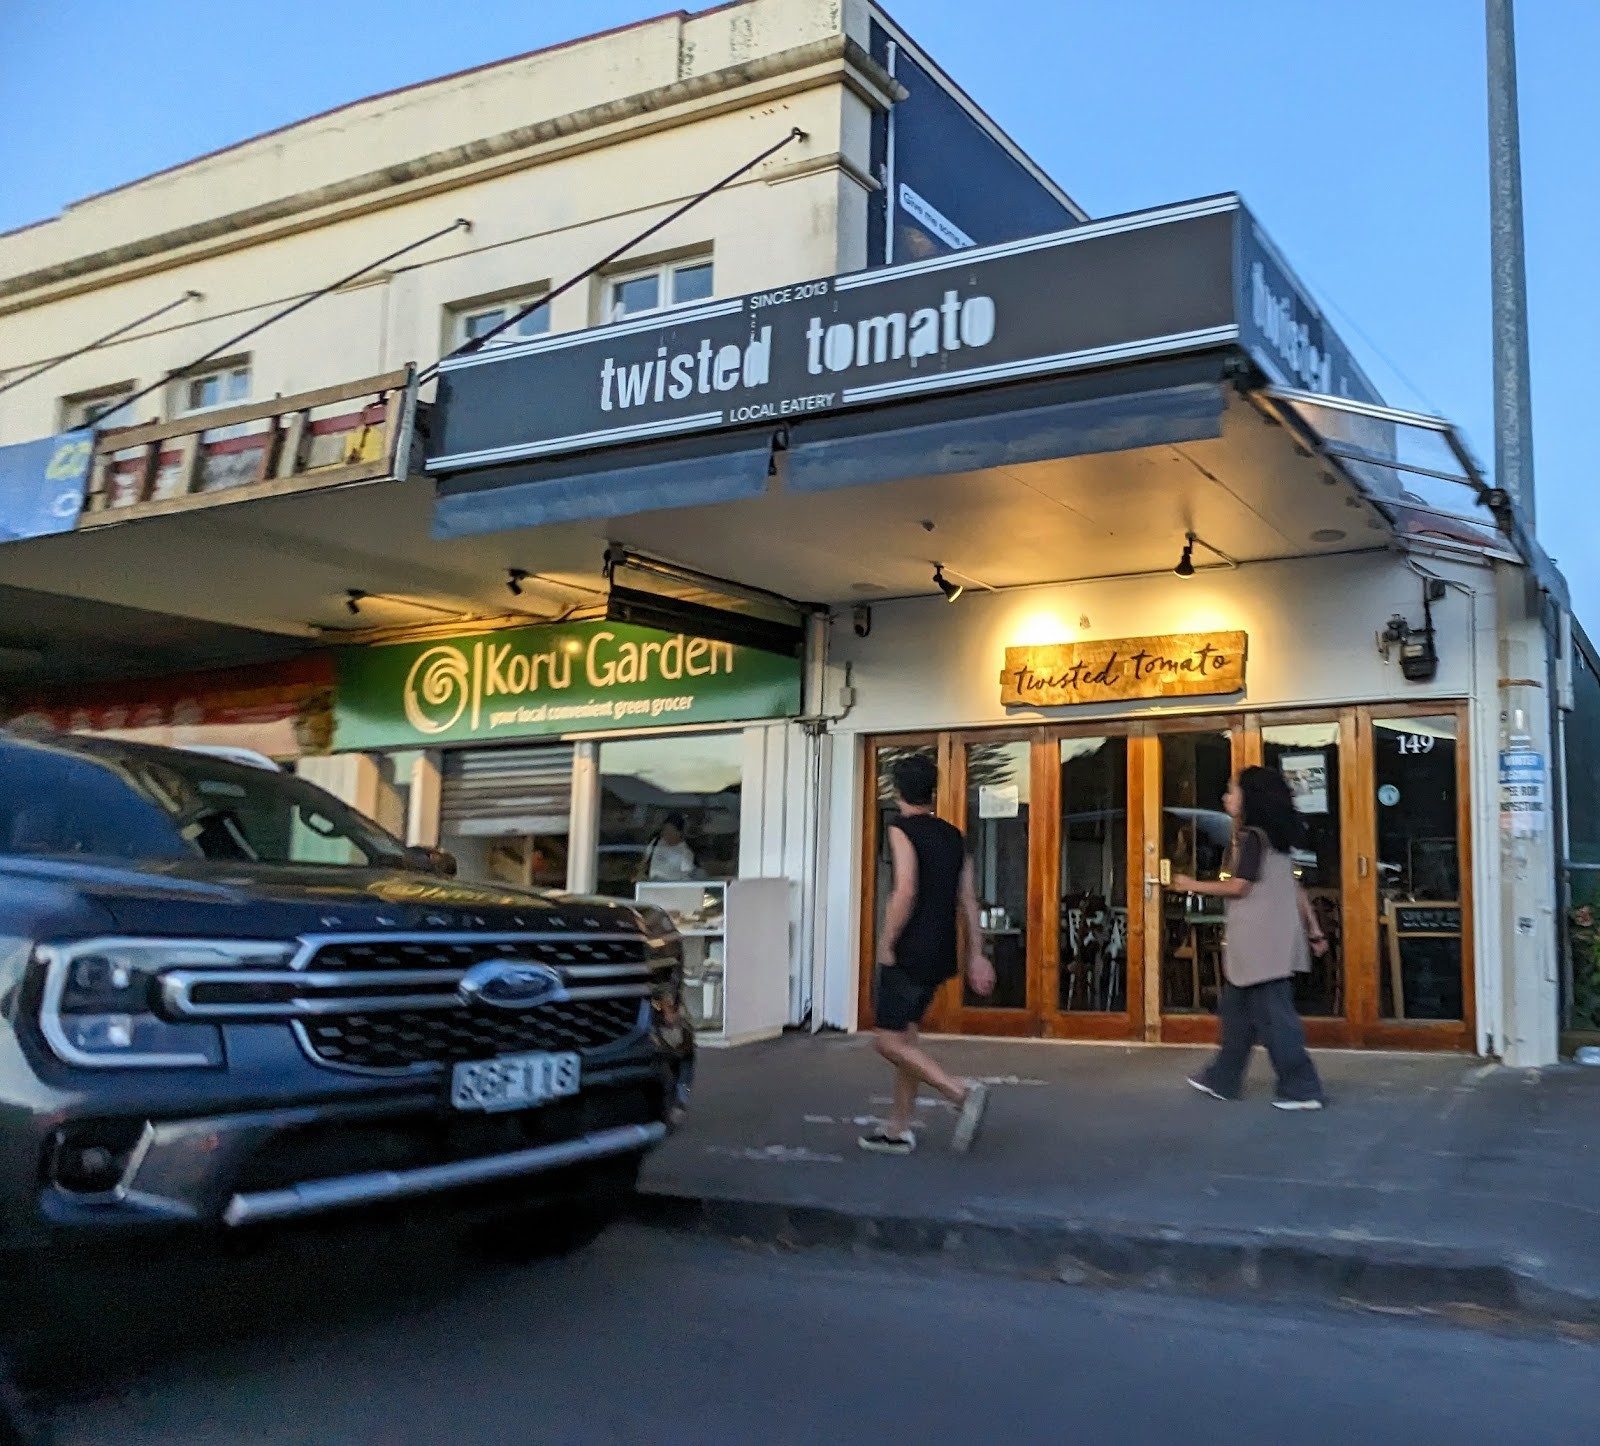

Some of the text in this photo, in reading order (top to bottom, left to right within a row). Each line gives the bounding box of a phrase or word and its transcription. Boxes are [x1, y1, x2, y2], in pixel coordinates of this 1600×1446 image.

[749, 281, 829, 310] SINCE 2013
[600, 289, 997, 411] twisted tomato
[729, 392, 836, 423] LOCAL EATERY
[485, 631, 734, 697] Koru Garden
[1013, 642, 1232, 695] twisted tomato
[517, 704, 548, 722] local
[613, 700, 650, 720] green
[651, 695, 694, 717] grocer
[1396, 733, 1436, 755] 149
